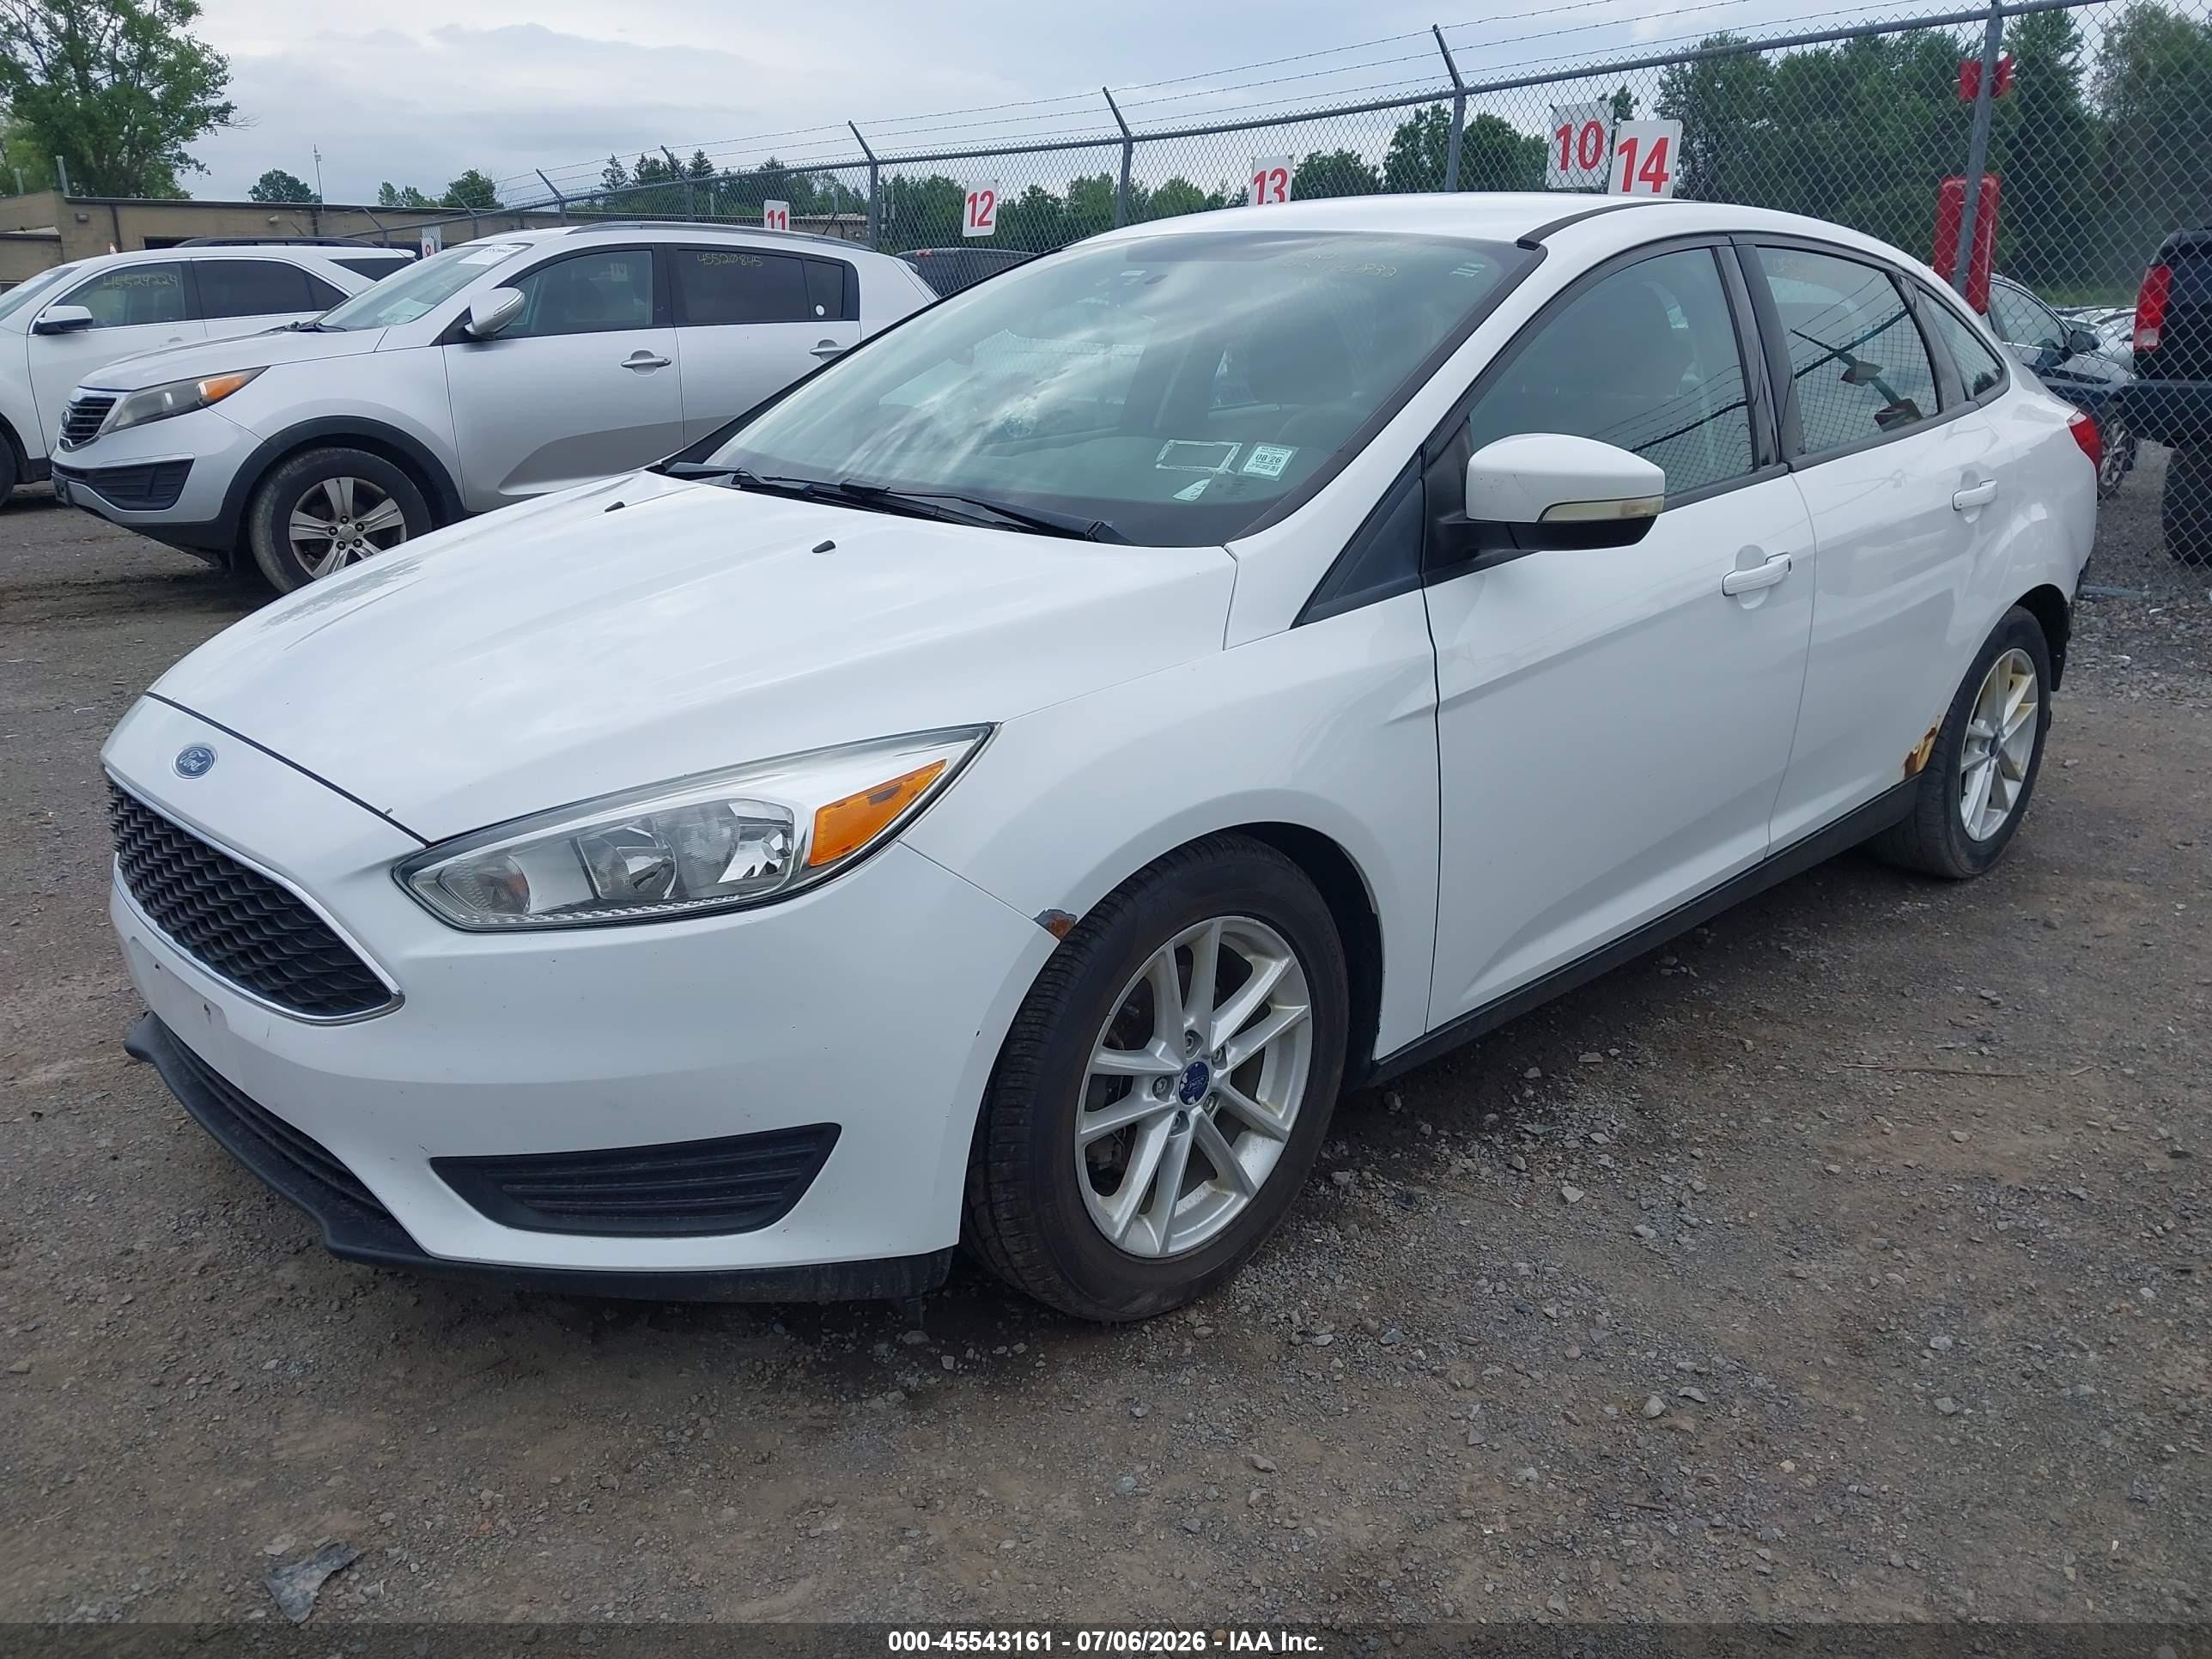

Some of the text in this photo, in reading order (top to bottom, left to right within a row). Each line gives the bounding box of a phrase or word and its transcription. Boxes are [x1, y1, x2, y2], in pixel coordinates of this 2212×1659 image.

[1555, 120, 1604, 171] 10
[1617, 137, 1670, 193] 14
[1253, 167, 1288, 205] 13
[767, 210, 787, 230] 11
[967, 190, 994, 228] 12
[1268, 454, 1283, 464] 26
[179, 750, 206, 771] Ford
